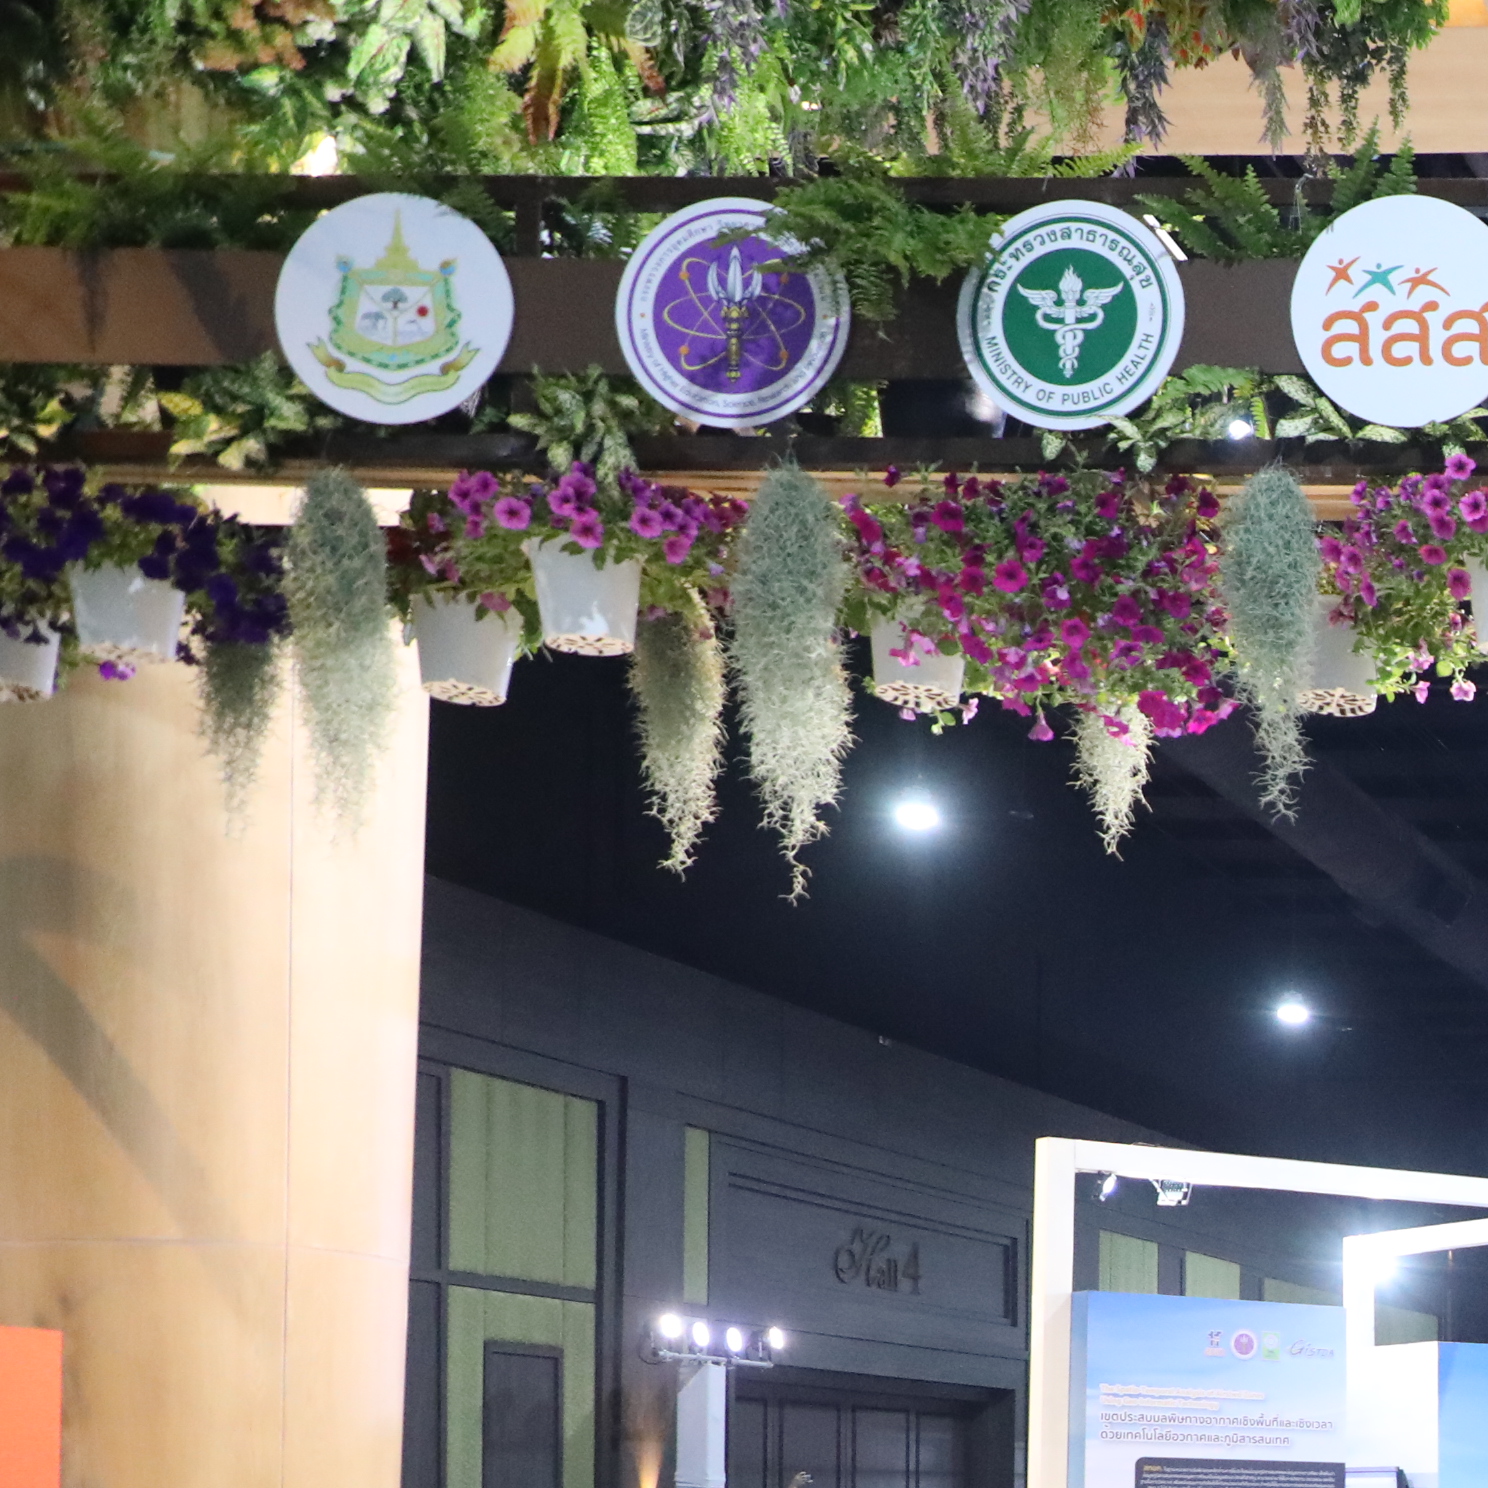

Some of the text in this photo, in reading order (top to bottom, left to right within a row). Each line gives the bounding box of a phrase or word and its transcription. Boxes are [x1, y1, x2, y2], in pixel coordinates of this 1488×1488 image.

[987, 226, 1153, 293] กระทรวงสาธารณสุข
[985, 333, 1154, 405] MINISTRY OF PUBLIC HEALTH
[834, 1225, 921, 1295] Hall 4
[1100, 1425, 1290, 1446] ด้วยเทคโนโลยีอวกาศและภูมิสารสนเทศ
[1101, 1411, 1333, 1429] เขตประสบมลพิษทางอากาศเชิงพื้นที่และเชิงเวลา
